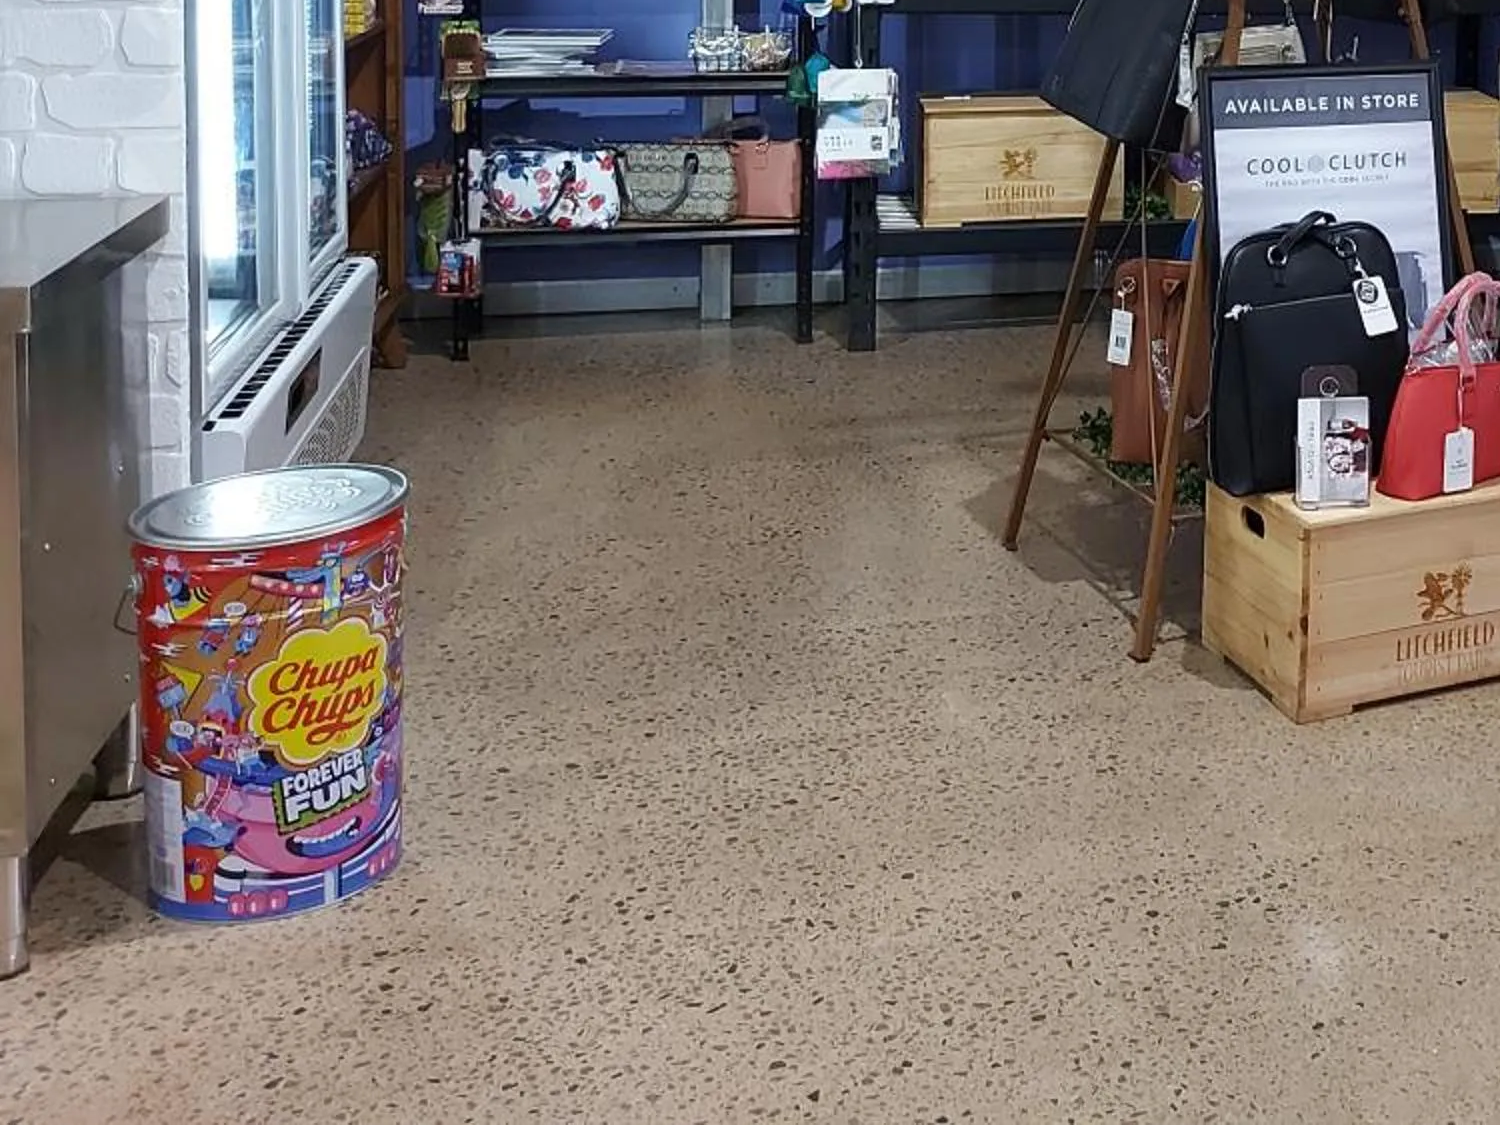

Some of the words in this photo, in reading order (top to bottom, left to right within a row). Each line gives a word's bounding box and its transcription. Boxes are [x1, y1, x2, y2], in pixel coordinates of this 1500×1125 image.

[1225, 96, 1329, 115] AVAILABLE
[1336, 95, 1355, 110] IN
[1362, 93, 1419, 110] STORE
[1247, 157, 1304, 176] COOL
[1329, 151, 1407, 171] CLUTCH
[1396, 620, 1495, 662] LITCHFIELD
[269, 646, 379, 695] Chupa
[261, 678, 376, 745] Chups
[281, 748, 364, 798] FOREVER
[284, 768, 367, 824] FUN
